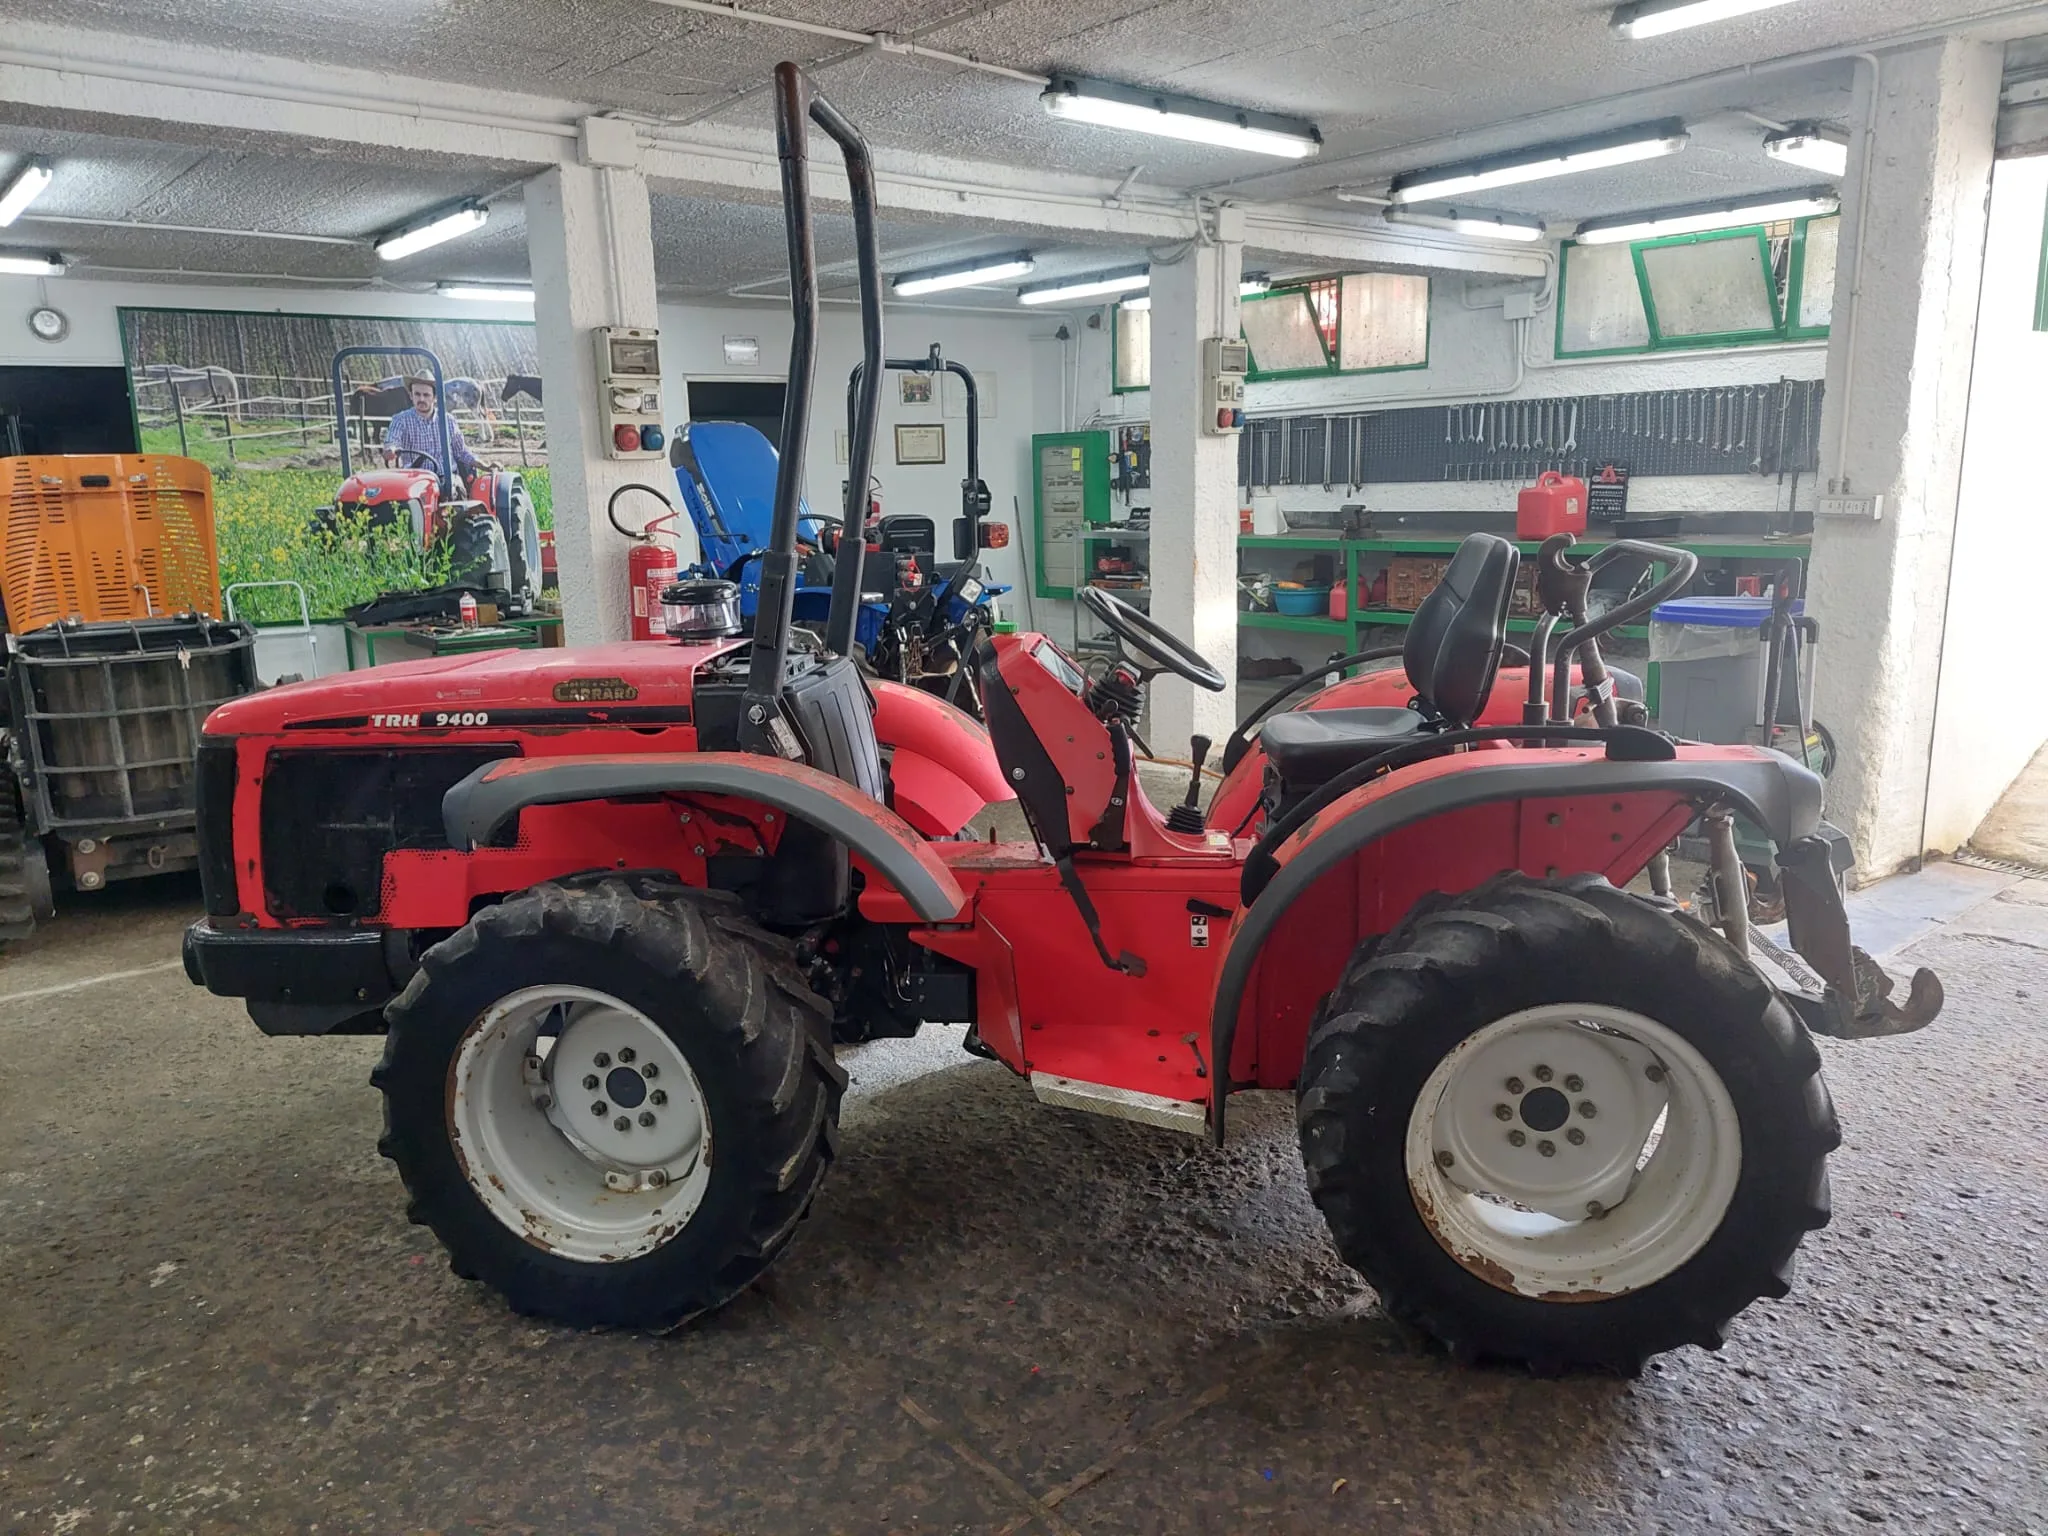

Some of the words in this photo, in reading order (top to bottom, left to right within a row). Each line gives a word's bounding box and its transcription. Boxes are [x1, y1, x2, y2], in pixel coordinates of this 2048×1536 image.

[554, 682, 638, 701] CARRARO
[372, 714, 419, 728] TRH
[436, 712, 489, 727] 9400
